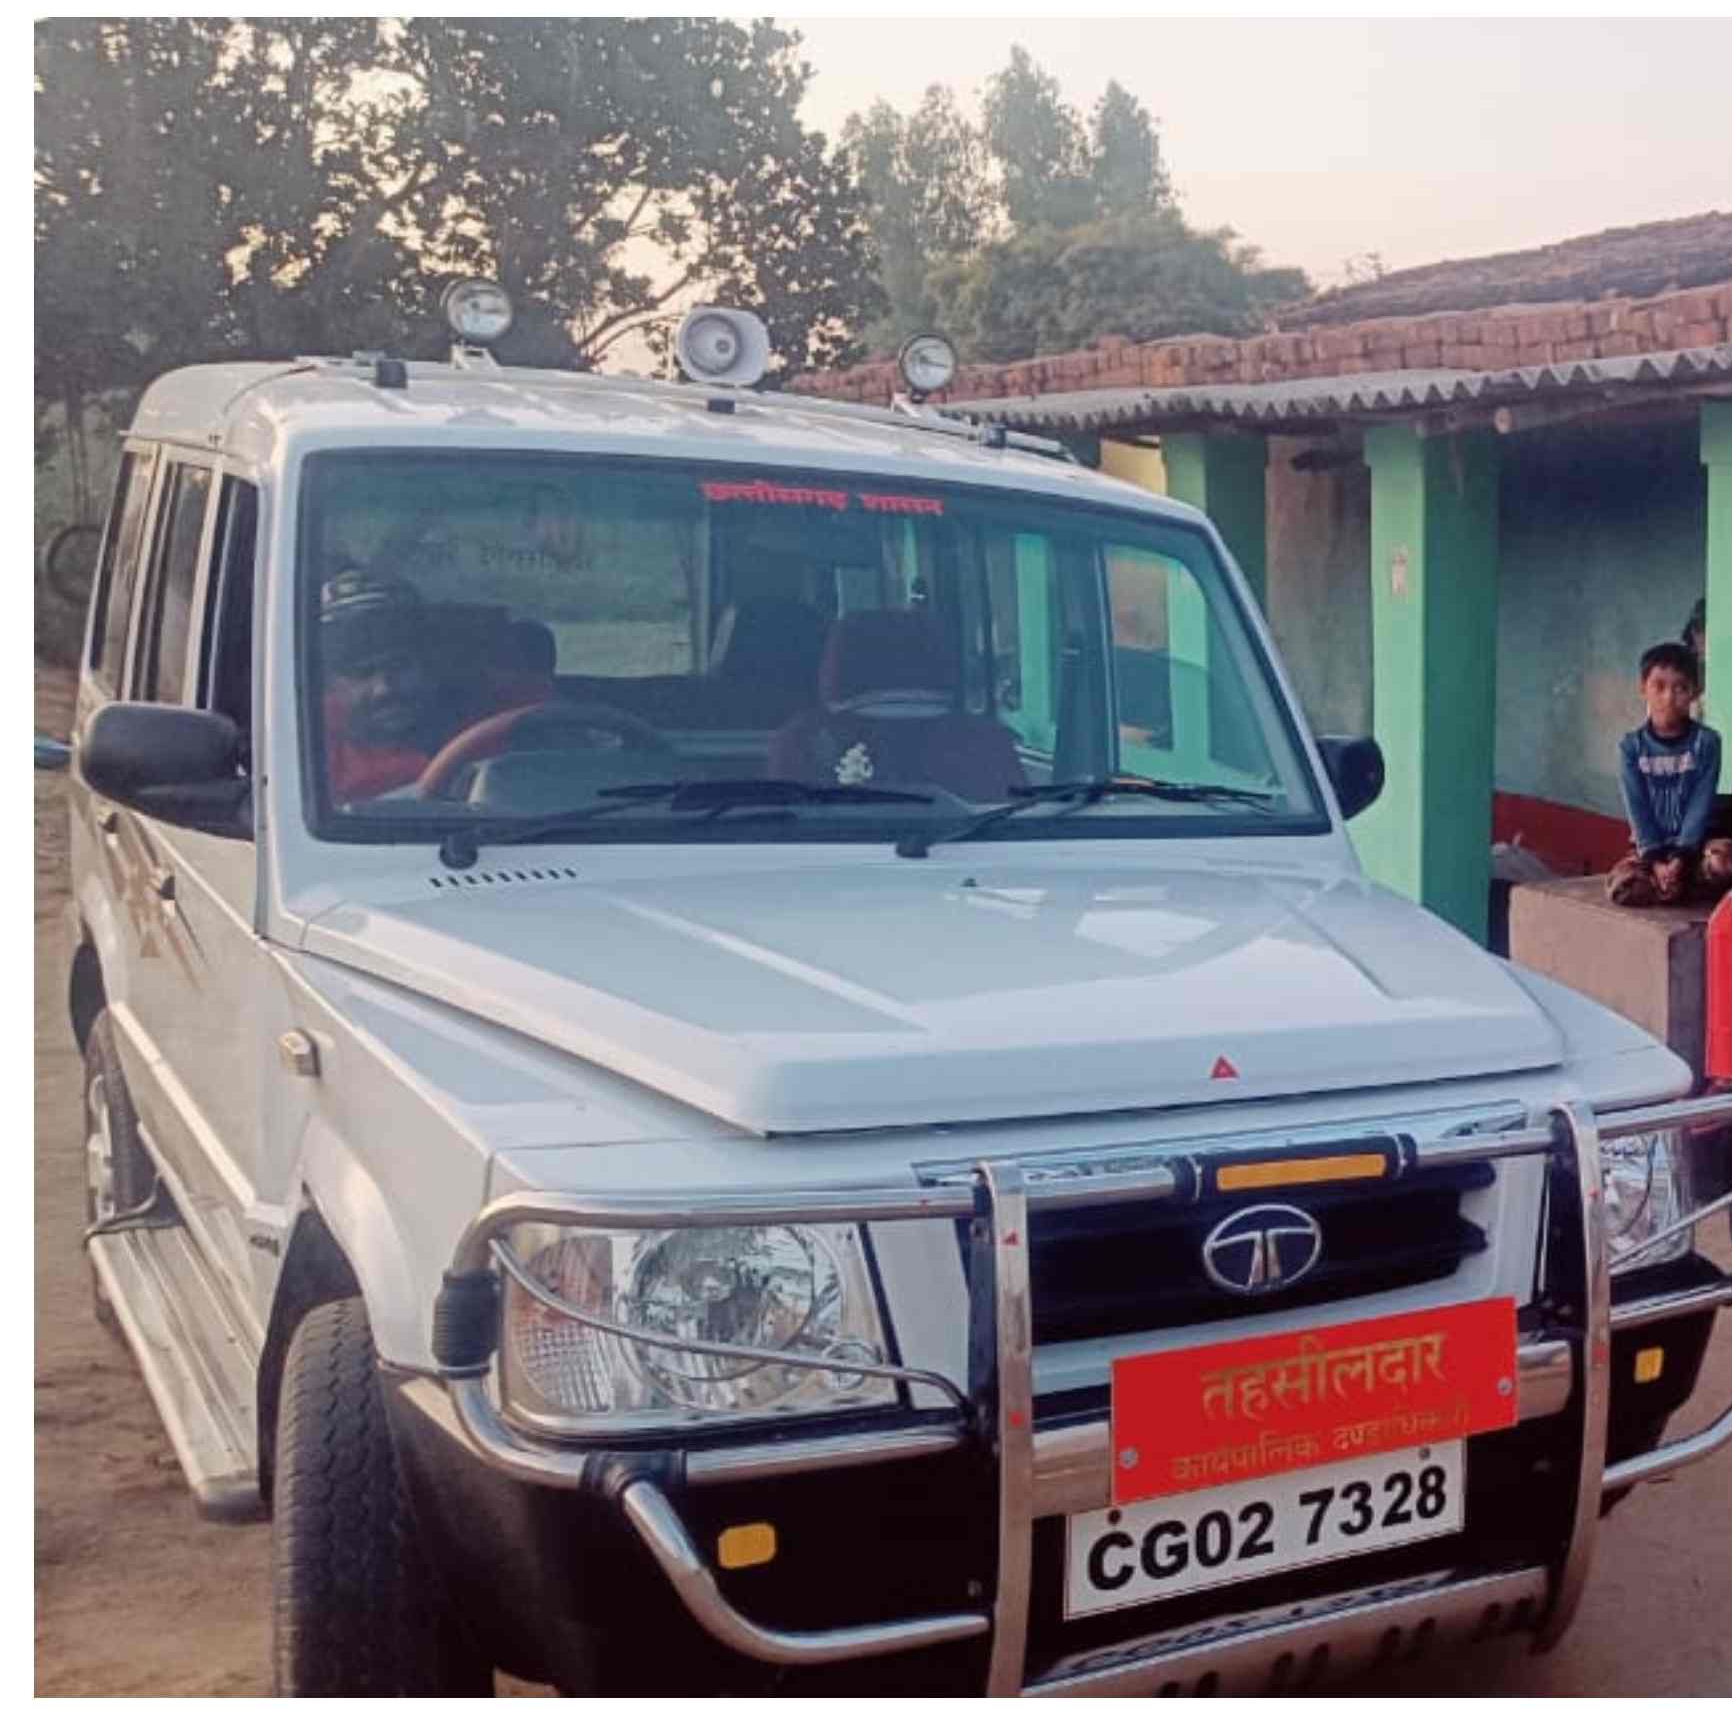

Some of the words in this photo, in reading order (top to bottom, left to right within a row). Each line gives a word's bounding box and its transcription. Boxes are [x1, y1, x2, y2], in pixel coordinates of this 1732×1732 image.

[1199, 1329, 1449, 1423] तहसीलदार
[1086, 1499, 1276, 1594] CG02
[1297, 1464, 1449, 1548] 7328
